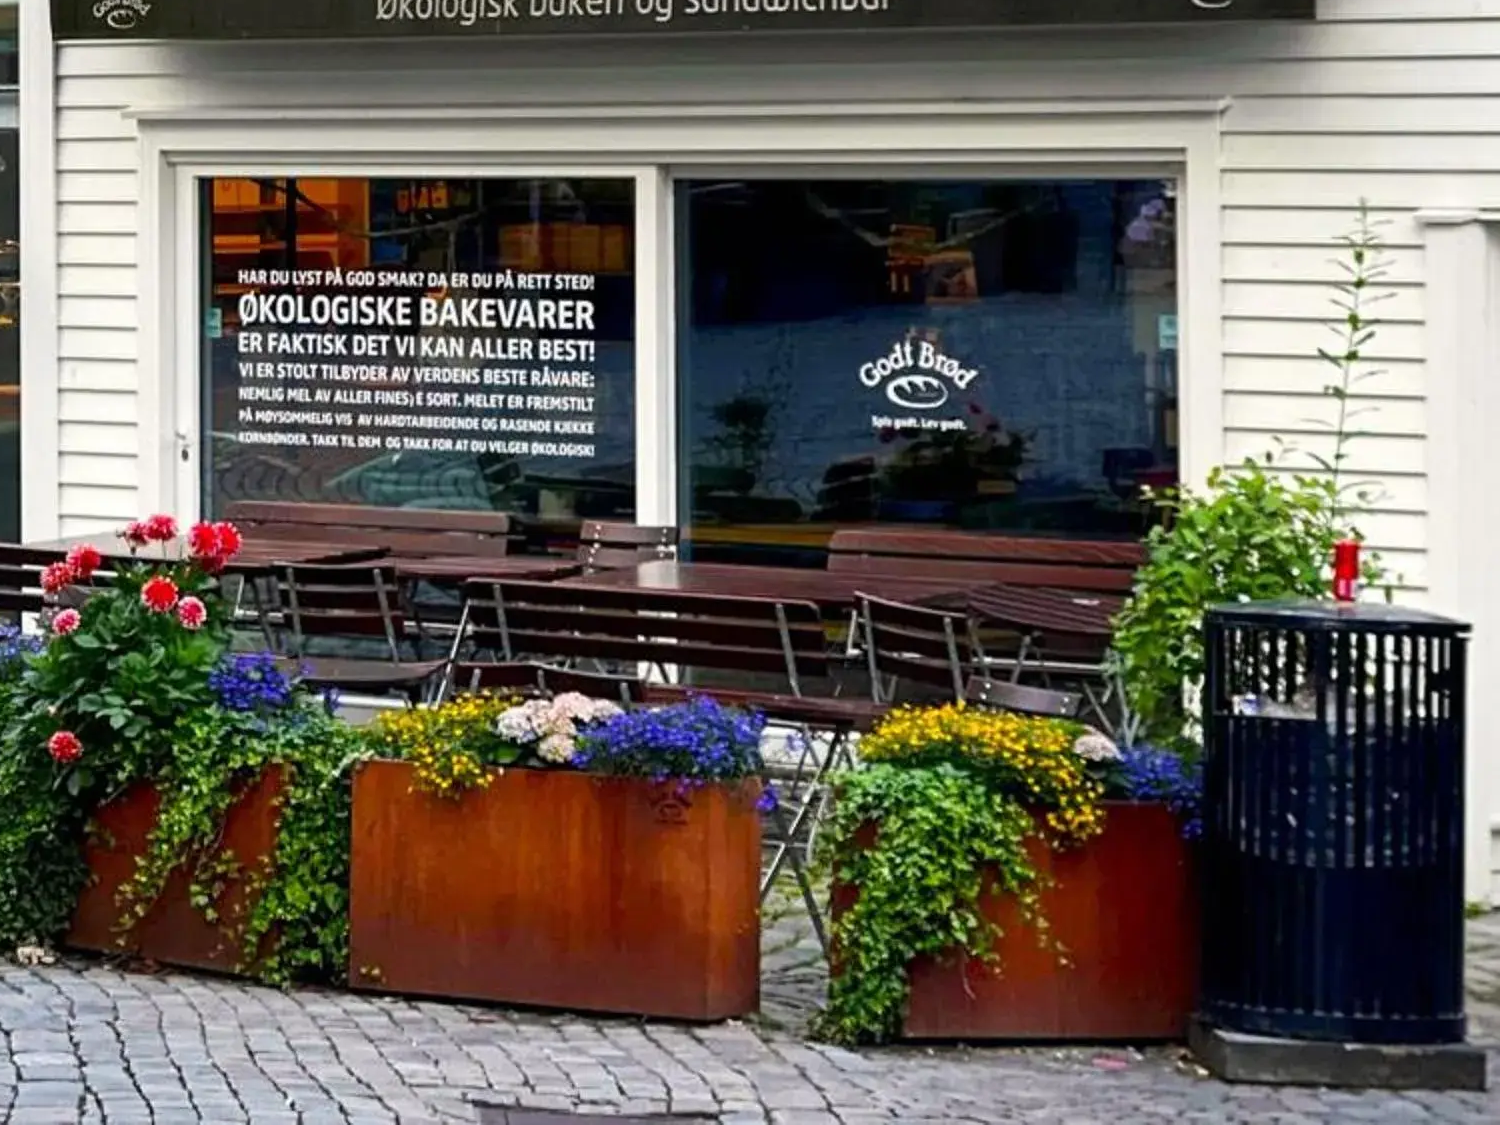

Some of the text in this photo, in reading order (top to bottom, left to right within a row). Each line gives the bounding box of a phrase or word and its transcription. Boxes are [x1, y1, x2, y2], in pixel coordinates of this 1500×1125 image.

[238, 267, 595, 290] HAR DU LYST PÅ GOD SMAK? DA ER DU PÅ RETT STED!
[239, 290, 595, 329] ØKOLOGISKE BAKEVARER
[238, 332, 595, 361] ER FAKTISK DET VI KAN ALLER BEST!
[239, 363, 595, 387] VI ER STOLT TILBYDER AV VERDENS BESTE RÅVARE:
[859, 340, 979, 389] Godt Brød
[238, 387, 285, 402] NEMLIG
[287, 388, 312, 402] MEL
[315, 389, 332, 402] AV
[334, 389, 372, 404] ALLER
[426, 393, 461, 407] SORT.
[463, 393, 505, 408] MELET
[508, 395, 524, 409] ER
[527, 395, 595, 412] FREMSTILT
[238, 406, 253, 421] PÅ
[335, 412, 353, 425] VIS
[357, 413, 373, 426] AV
[482, 417, 498, 430] OG
[500, 418, 551, 432] RASENDE
[553, 420, 595, 434] KJEKKE
[312, 433, 338, 447] TAKK
[341, 434, 356, 447] TIL
[357, 435, 381, 448] DEM
[385, 436, 401, 449] OG
[403, 437, 430, 450] TAKK
[432, 438, 453, 451] FOR
[455, 439, 469, 452] AT
[471, 440, 487, 453] DU
[489, 440, 529, 454] VELGER
